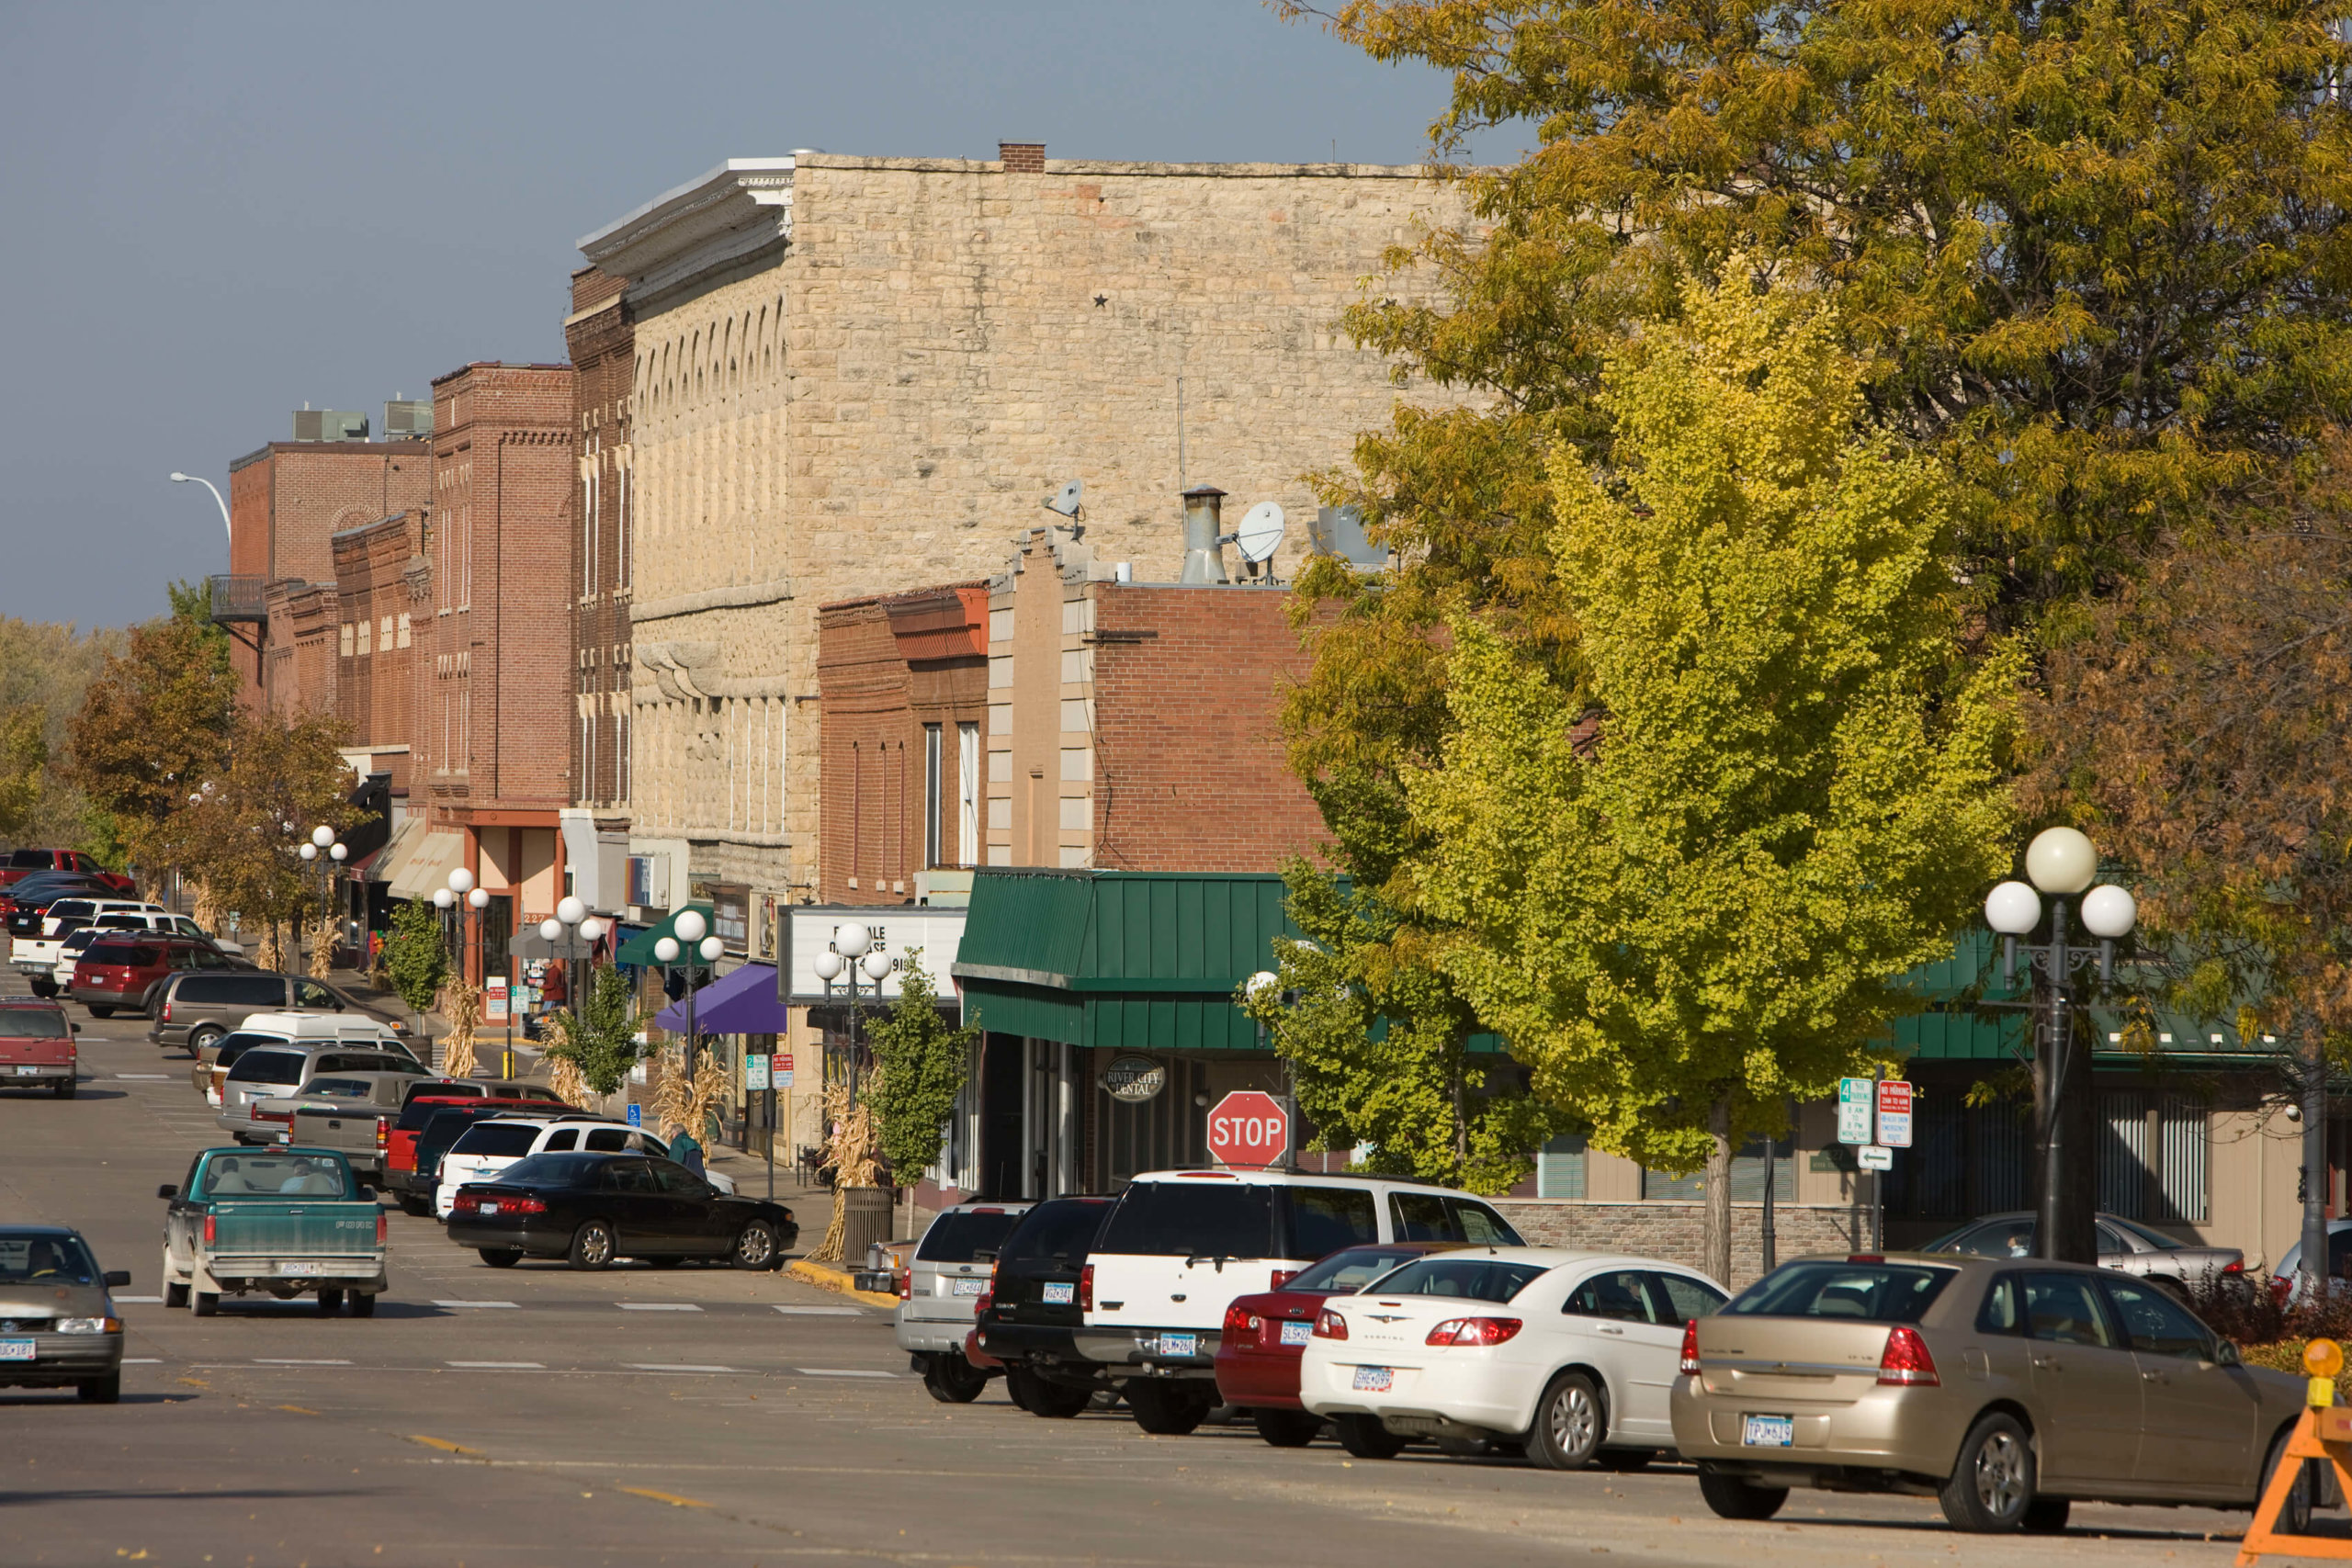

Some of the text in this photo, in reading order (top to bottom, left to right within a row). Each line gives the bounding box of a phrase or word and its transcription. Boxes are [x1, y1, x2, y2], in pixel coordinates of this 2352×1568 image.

[525, 914, 545, 923] 227
[748, 1057, 753, 1066] 2
[1107, 1071, 1159, 1084] RIVER CITY
[1115, 1083, 1150, 1095] DENTAL
[1842, 1083, 1849, 1100] 4
[1882, 1086, 1909, 1096] NO PARKING
[1855, 1106, 1864, 1114] AM
[1854, 1122, 1863, 1130] PM
[1214, 1117, 1282, 1146] STOP
